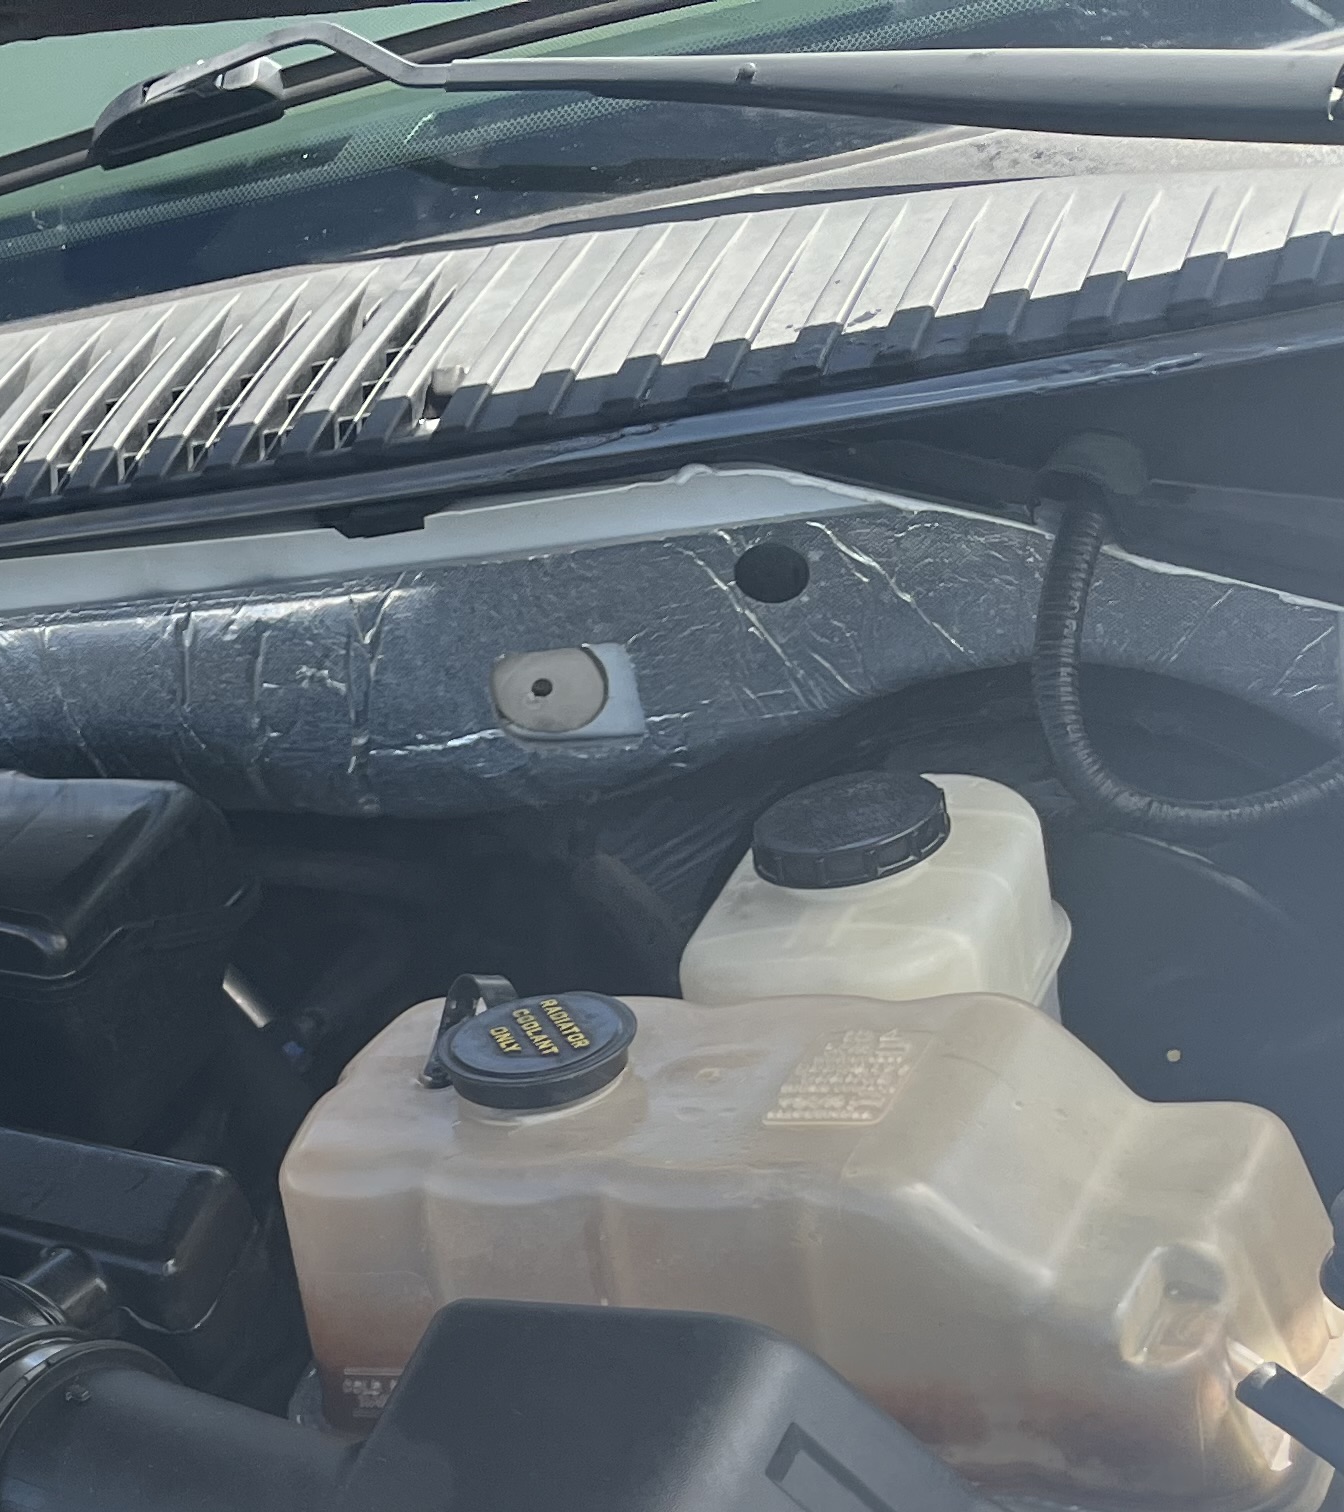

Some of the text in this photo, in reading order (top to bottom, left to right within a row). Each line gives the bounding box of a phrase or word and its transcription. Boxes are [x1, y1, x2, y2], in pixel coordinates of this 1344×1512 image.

[489, 1026, 522, 1054] ONLY
[512, 1008, 559, 1056] COOLANT
[540, 998, 591, 1050] RADIATOR
